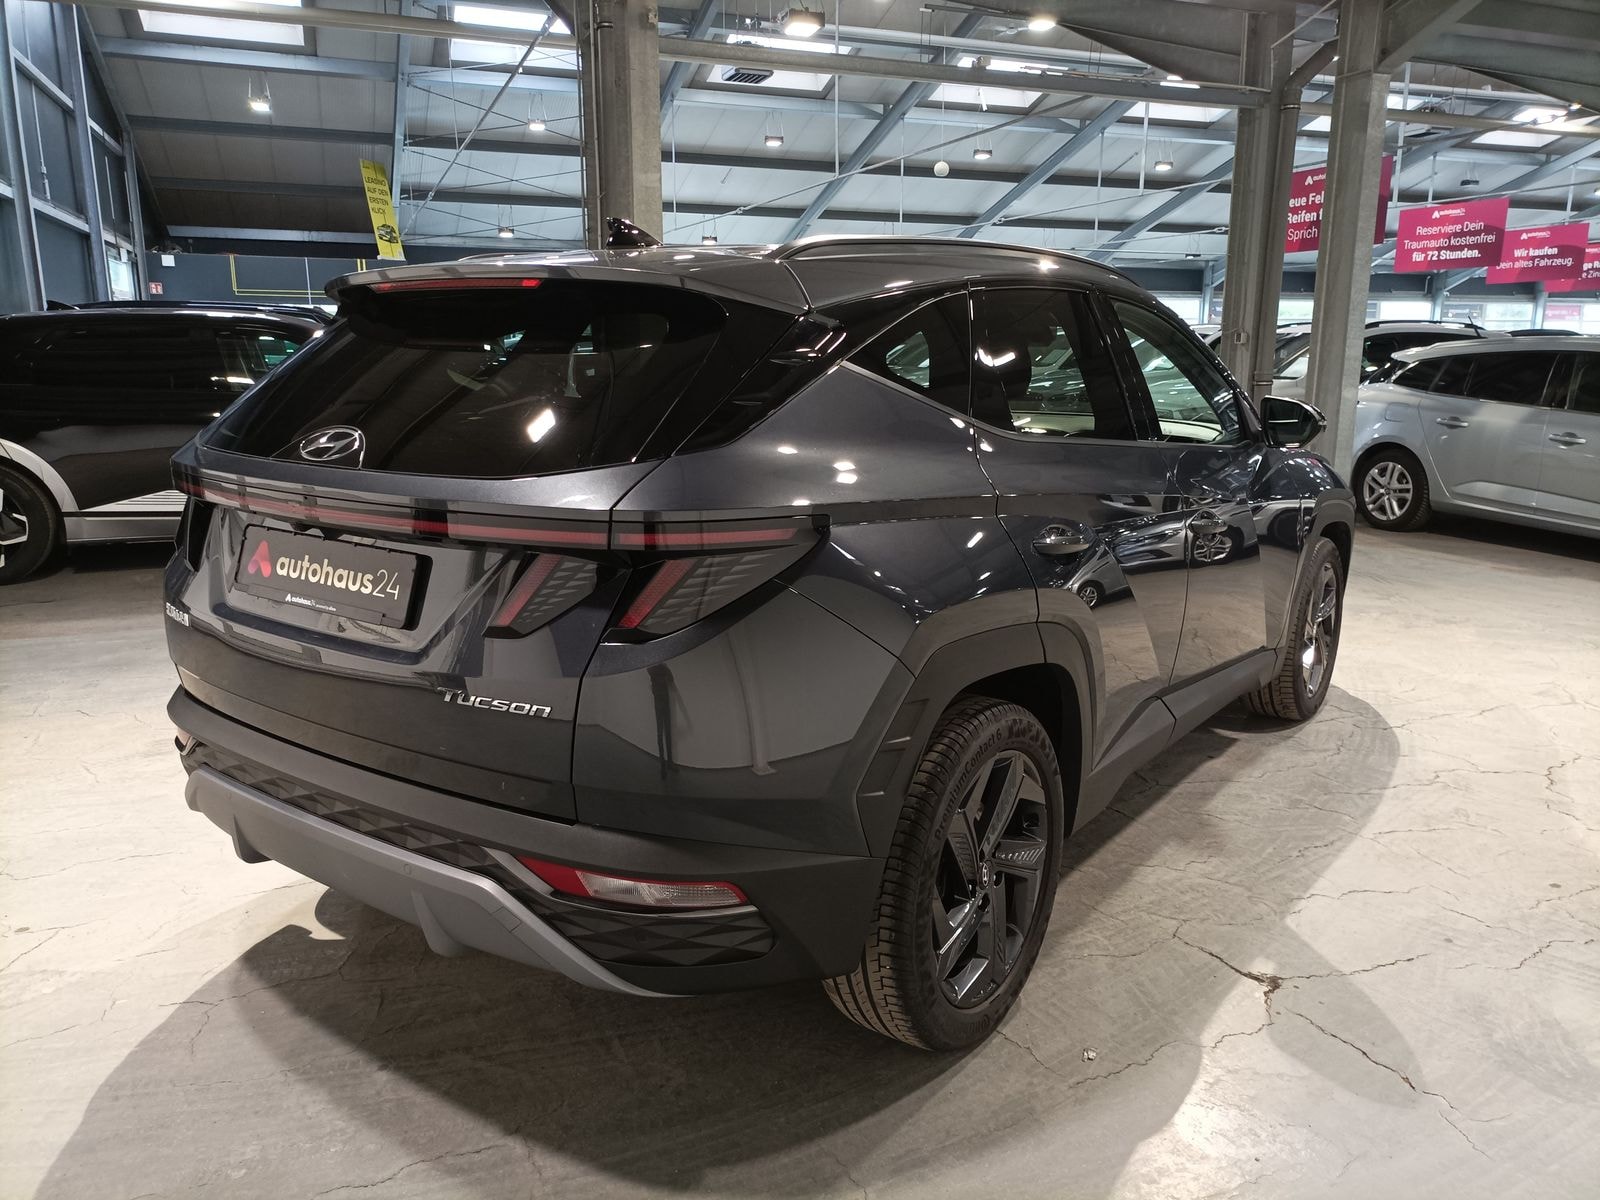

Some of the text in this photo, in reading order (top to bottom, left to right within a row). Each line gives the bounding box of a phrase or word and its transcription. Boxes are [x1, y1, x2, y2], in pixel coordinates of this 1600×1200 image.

[1287, 225, 1318, 242] Sprich
[1416, 221, 1484, 236] Reserviere Dein
[1404, 231, 1496, 250] Traumauto kostenfrei
[1412, 247, 1481, 262] für 72 Stunden.
[1513, 245, 1558, 258] Wir kaufen
[1514, 258, 1533, 268] altes
[1534, 256, 1574, 267] Fahrzeug.
[276, 555, 400, 600] autohaus24
[996, 728, 1003, 740] 6
